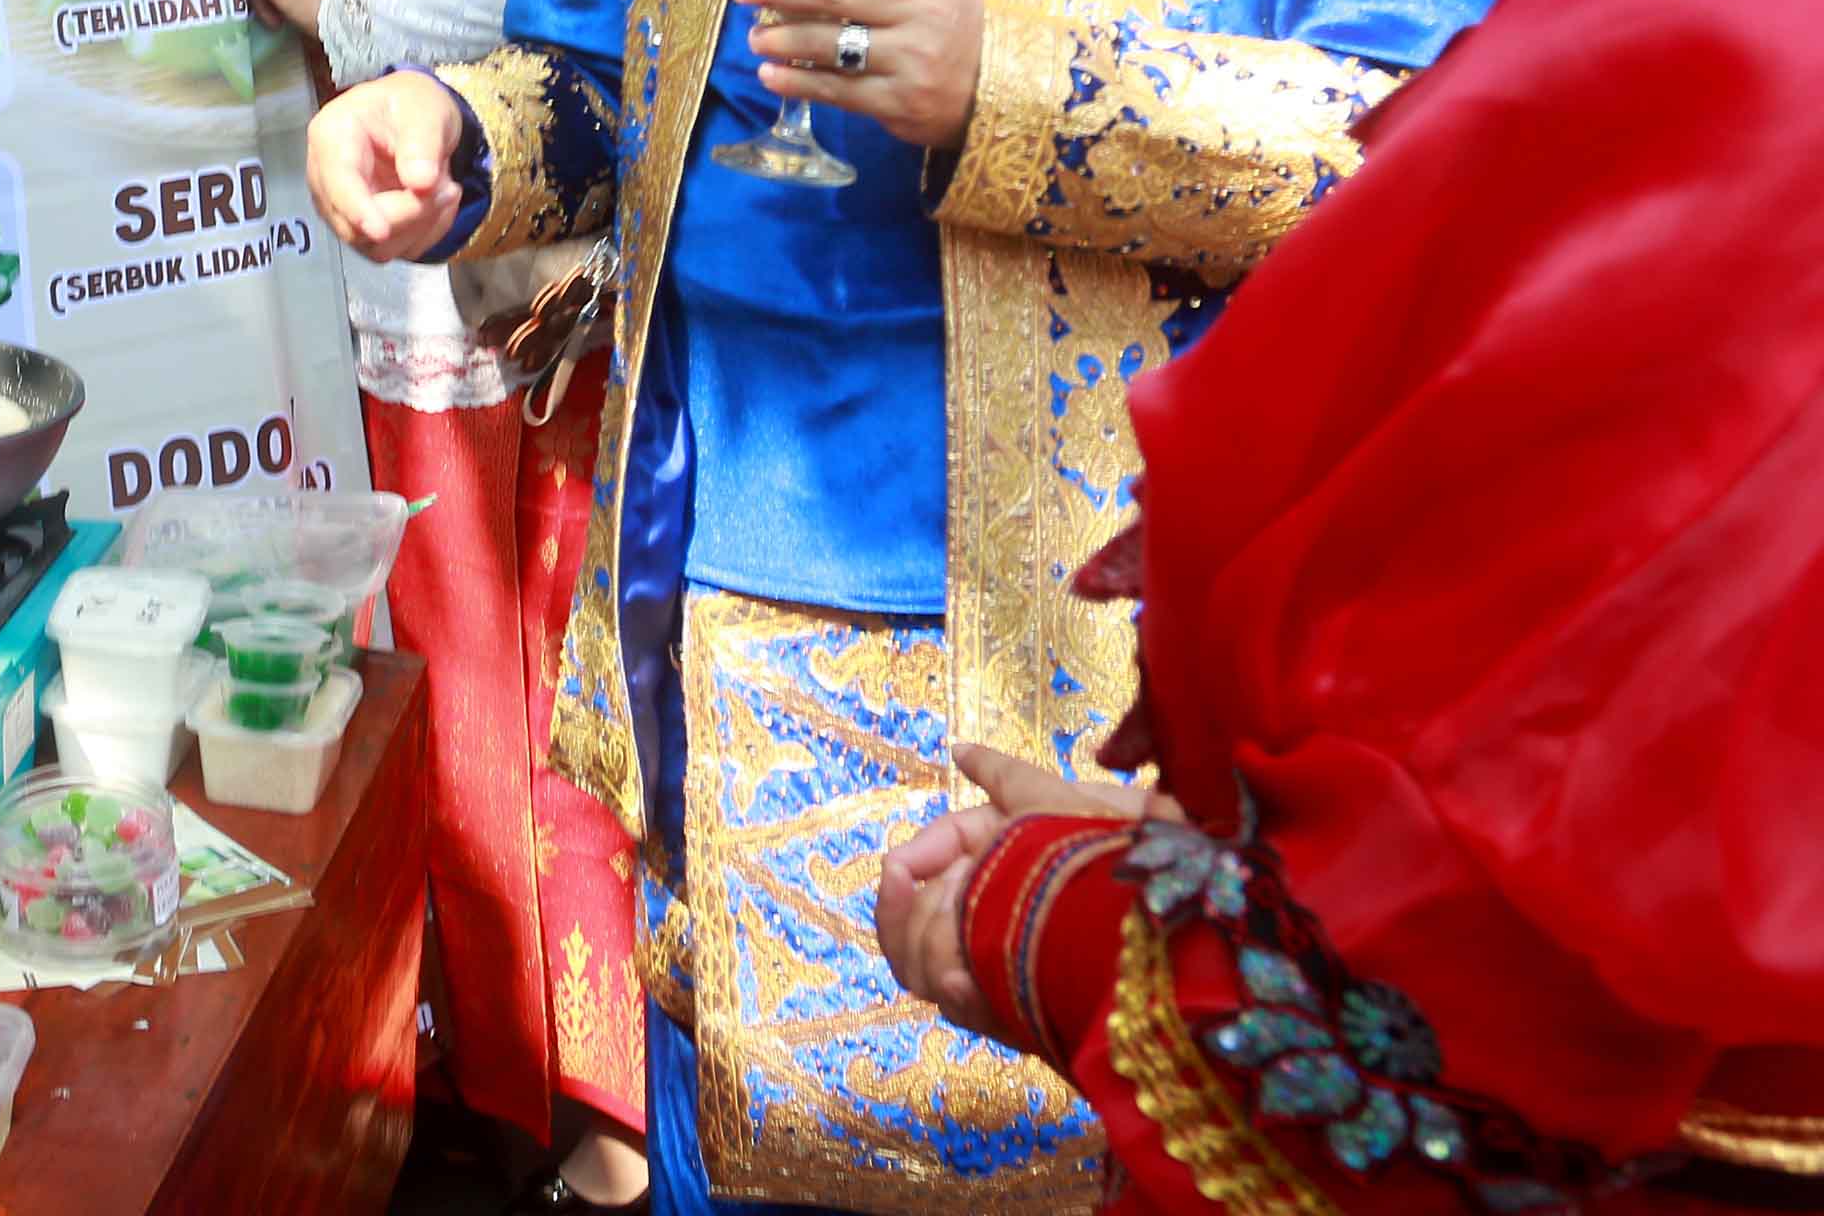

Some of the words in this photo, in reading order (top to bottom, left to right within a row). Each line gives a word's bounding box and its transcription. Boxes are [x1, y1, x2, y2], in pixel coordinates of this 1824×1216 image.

[56, 8, 127, 48] (TEH
[49, 256, 187, 314] (SERBUK
[195, 239, 273, 277] LIDAH
[108, 416, 293, 509] DODO
